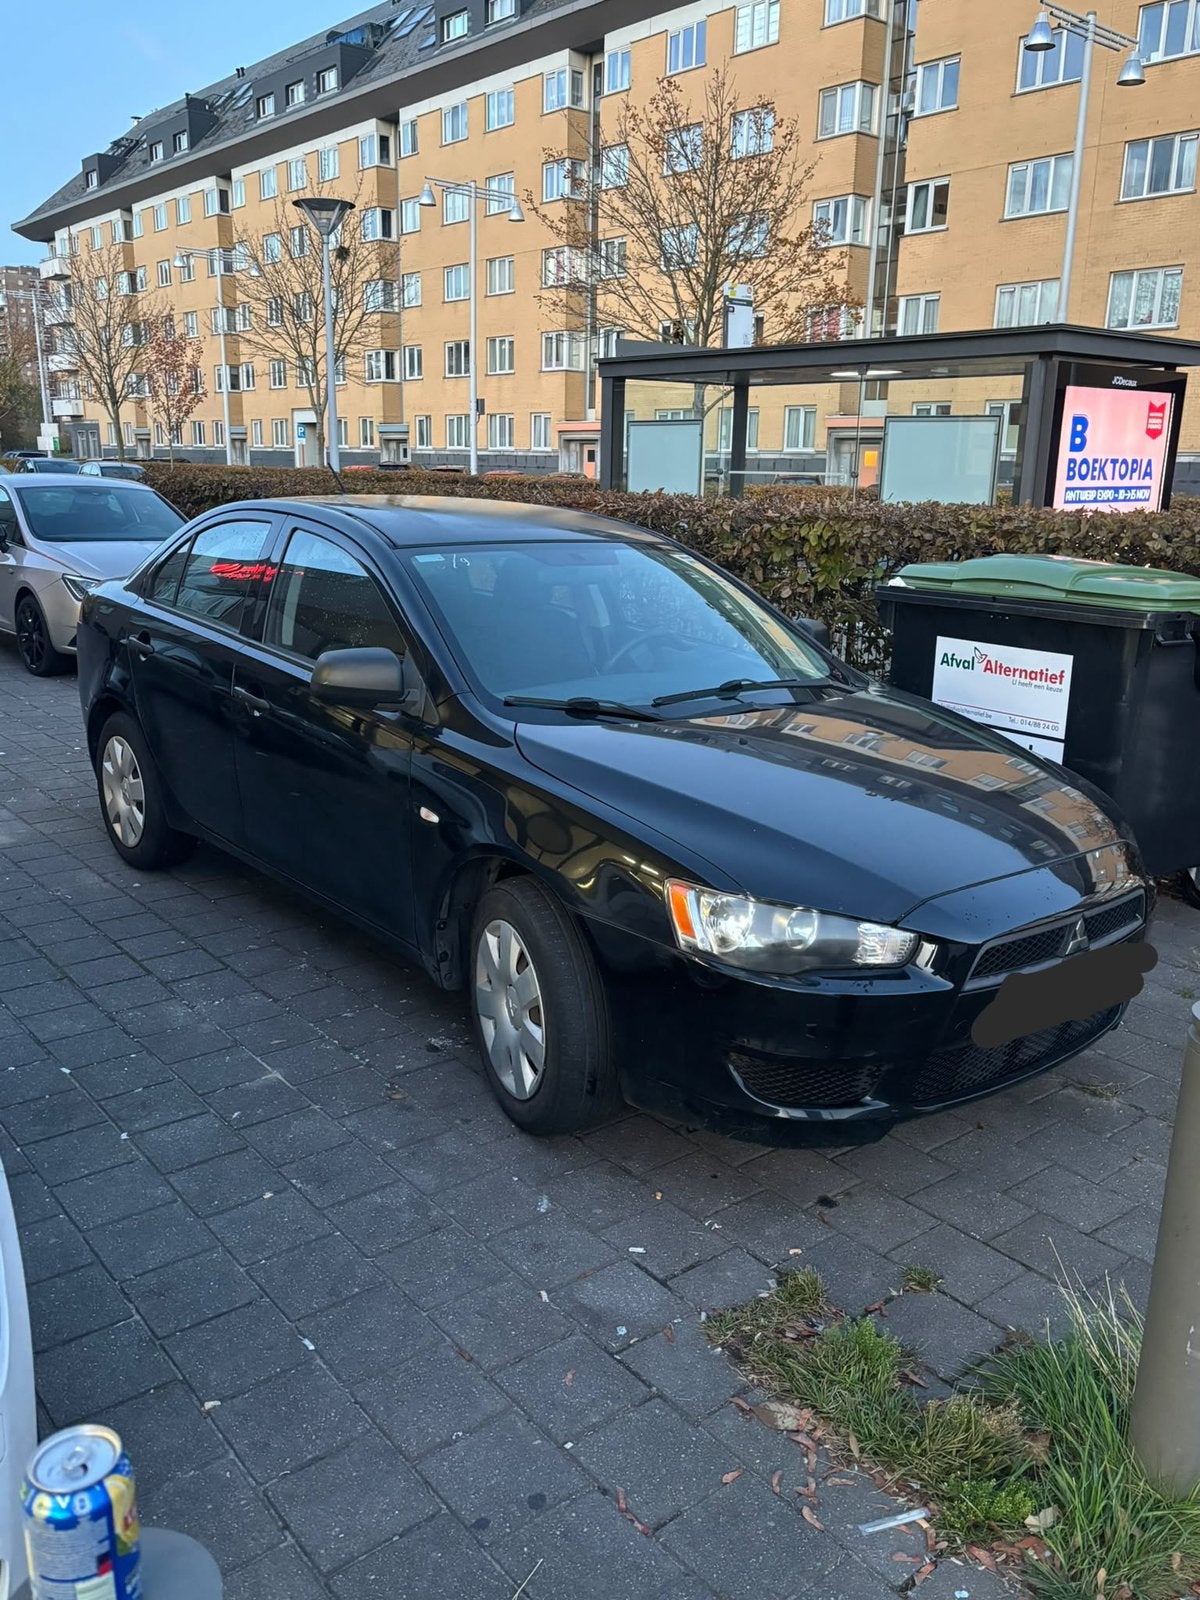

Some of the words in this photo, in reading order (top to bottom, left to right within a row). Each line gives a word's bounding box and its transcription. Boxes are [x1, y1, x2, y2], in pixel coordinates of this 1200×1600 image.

[1112, 375, 1137, 387] JCDecaux
[1069, 414, 1089, 452] B
[1066, 458, 1153, 481] BOEKTOPIA
[1065, 489, 1096, 501] ANTWERP
[1097, 489, 1115, 500] EXPO
[1137, 488, 1151, 500] NOV
[940, 652, 975, 671] Afval
[983, 660, 1065, 685] Alternatief
